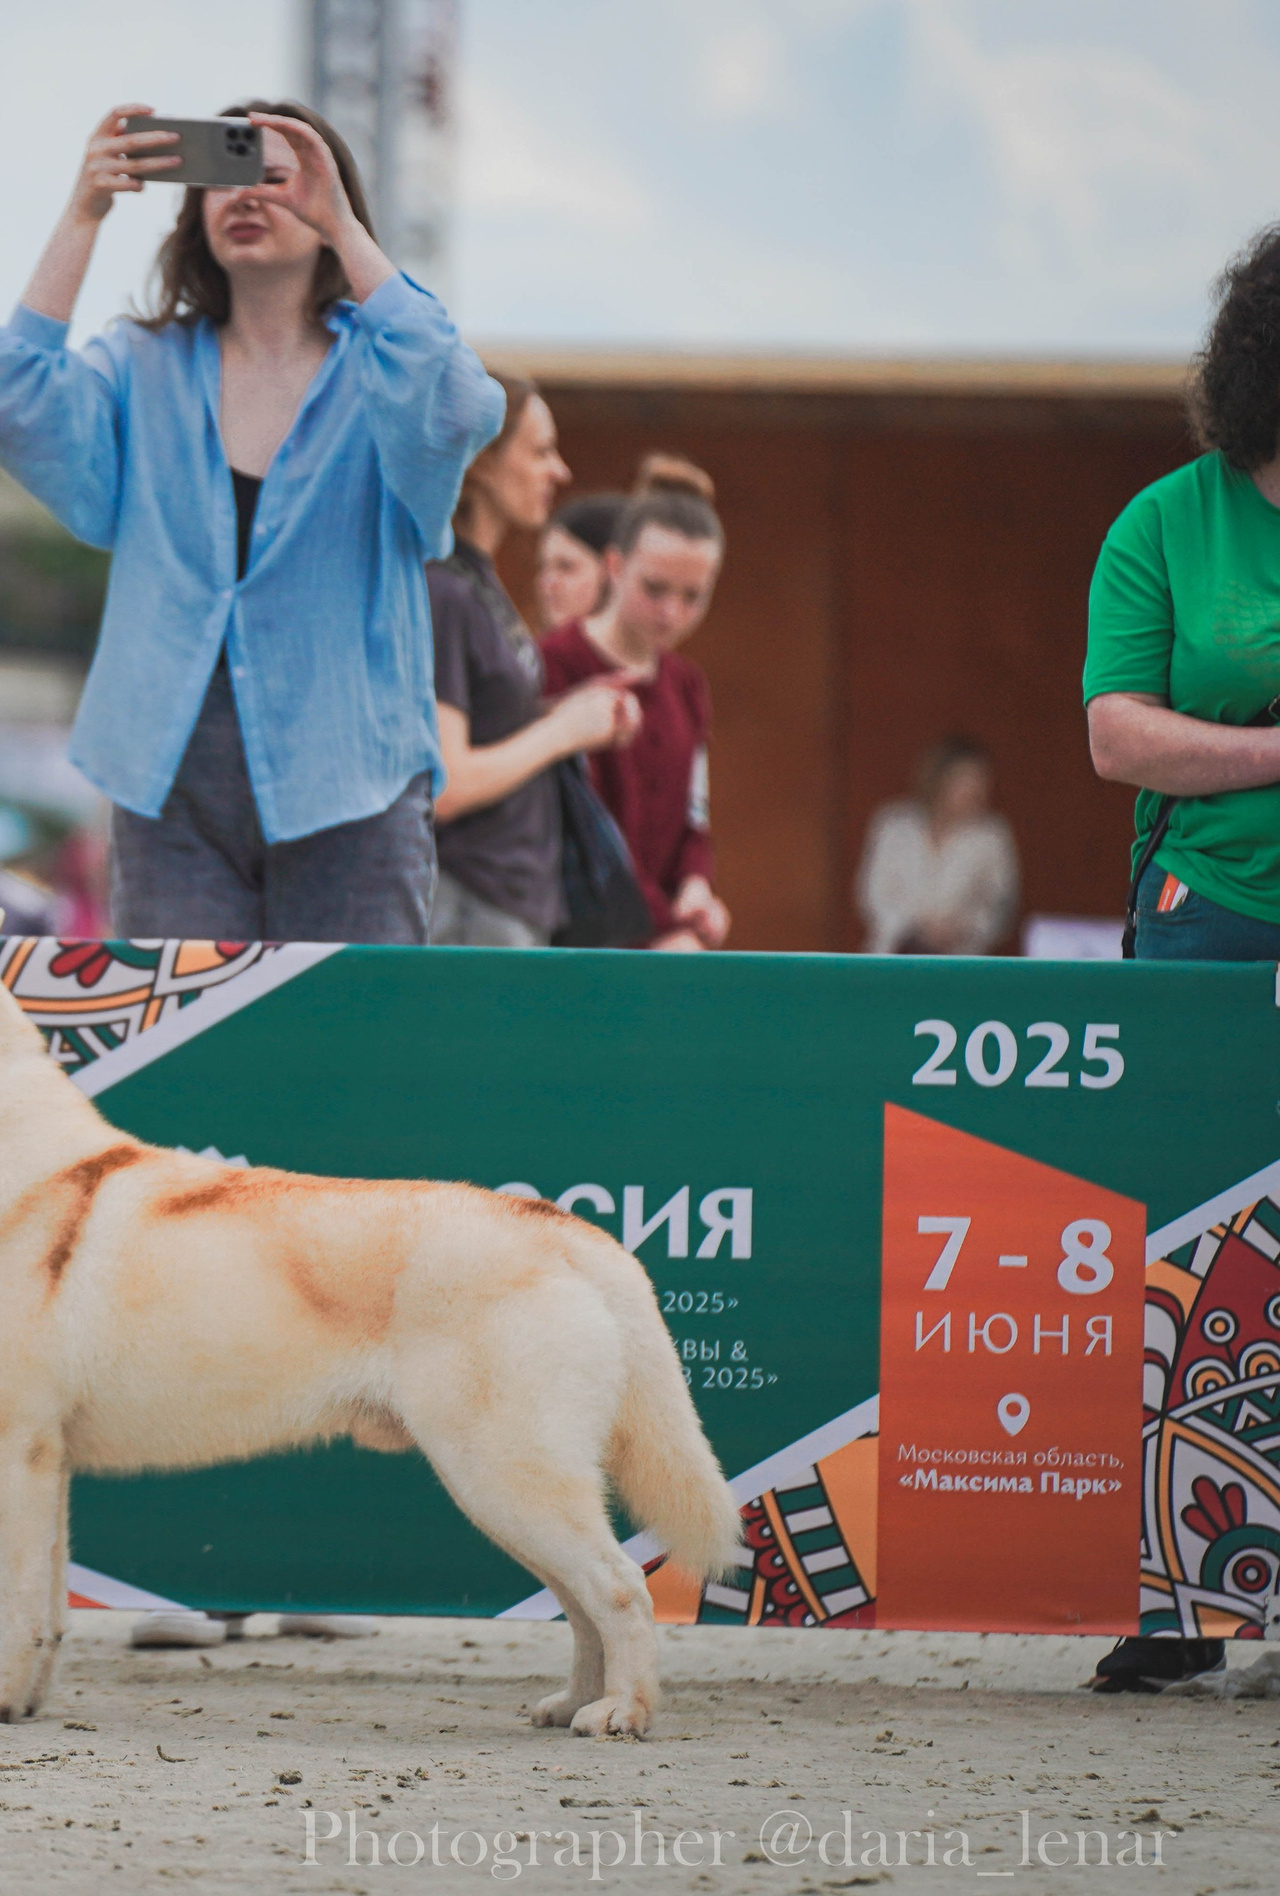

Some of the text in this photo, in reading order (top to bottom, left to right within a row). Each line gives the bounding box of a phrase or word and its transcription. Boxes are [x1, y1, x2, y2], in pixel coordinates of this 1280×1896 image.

[911, 1018, 1126, 1090] 2025
[916, 1215, 972, 1291] 7
[1056, 1218, 1115, 1295] 8
[662, 1290, 739, 1314] 2025»
[914, 1310, 1114, 1357] ИЮНЯ
[673, 1338, 720, 1361] ВЫ
[701, 1366, 779, 1390] 2025»
[896, 1443, 1126, 1470] Московская область,
[898, 1468, 1123, 1501] «Максима Парк»
